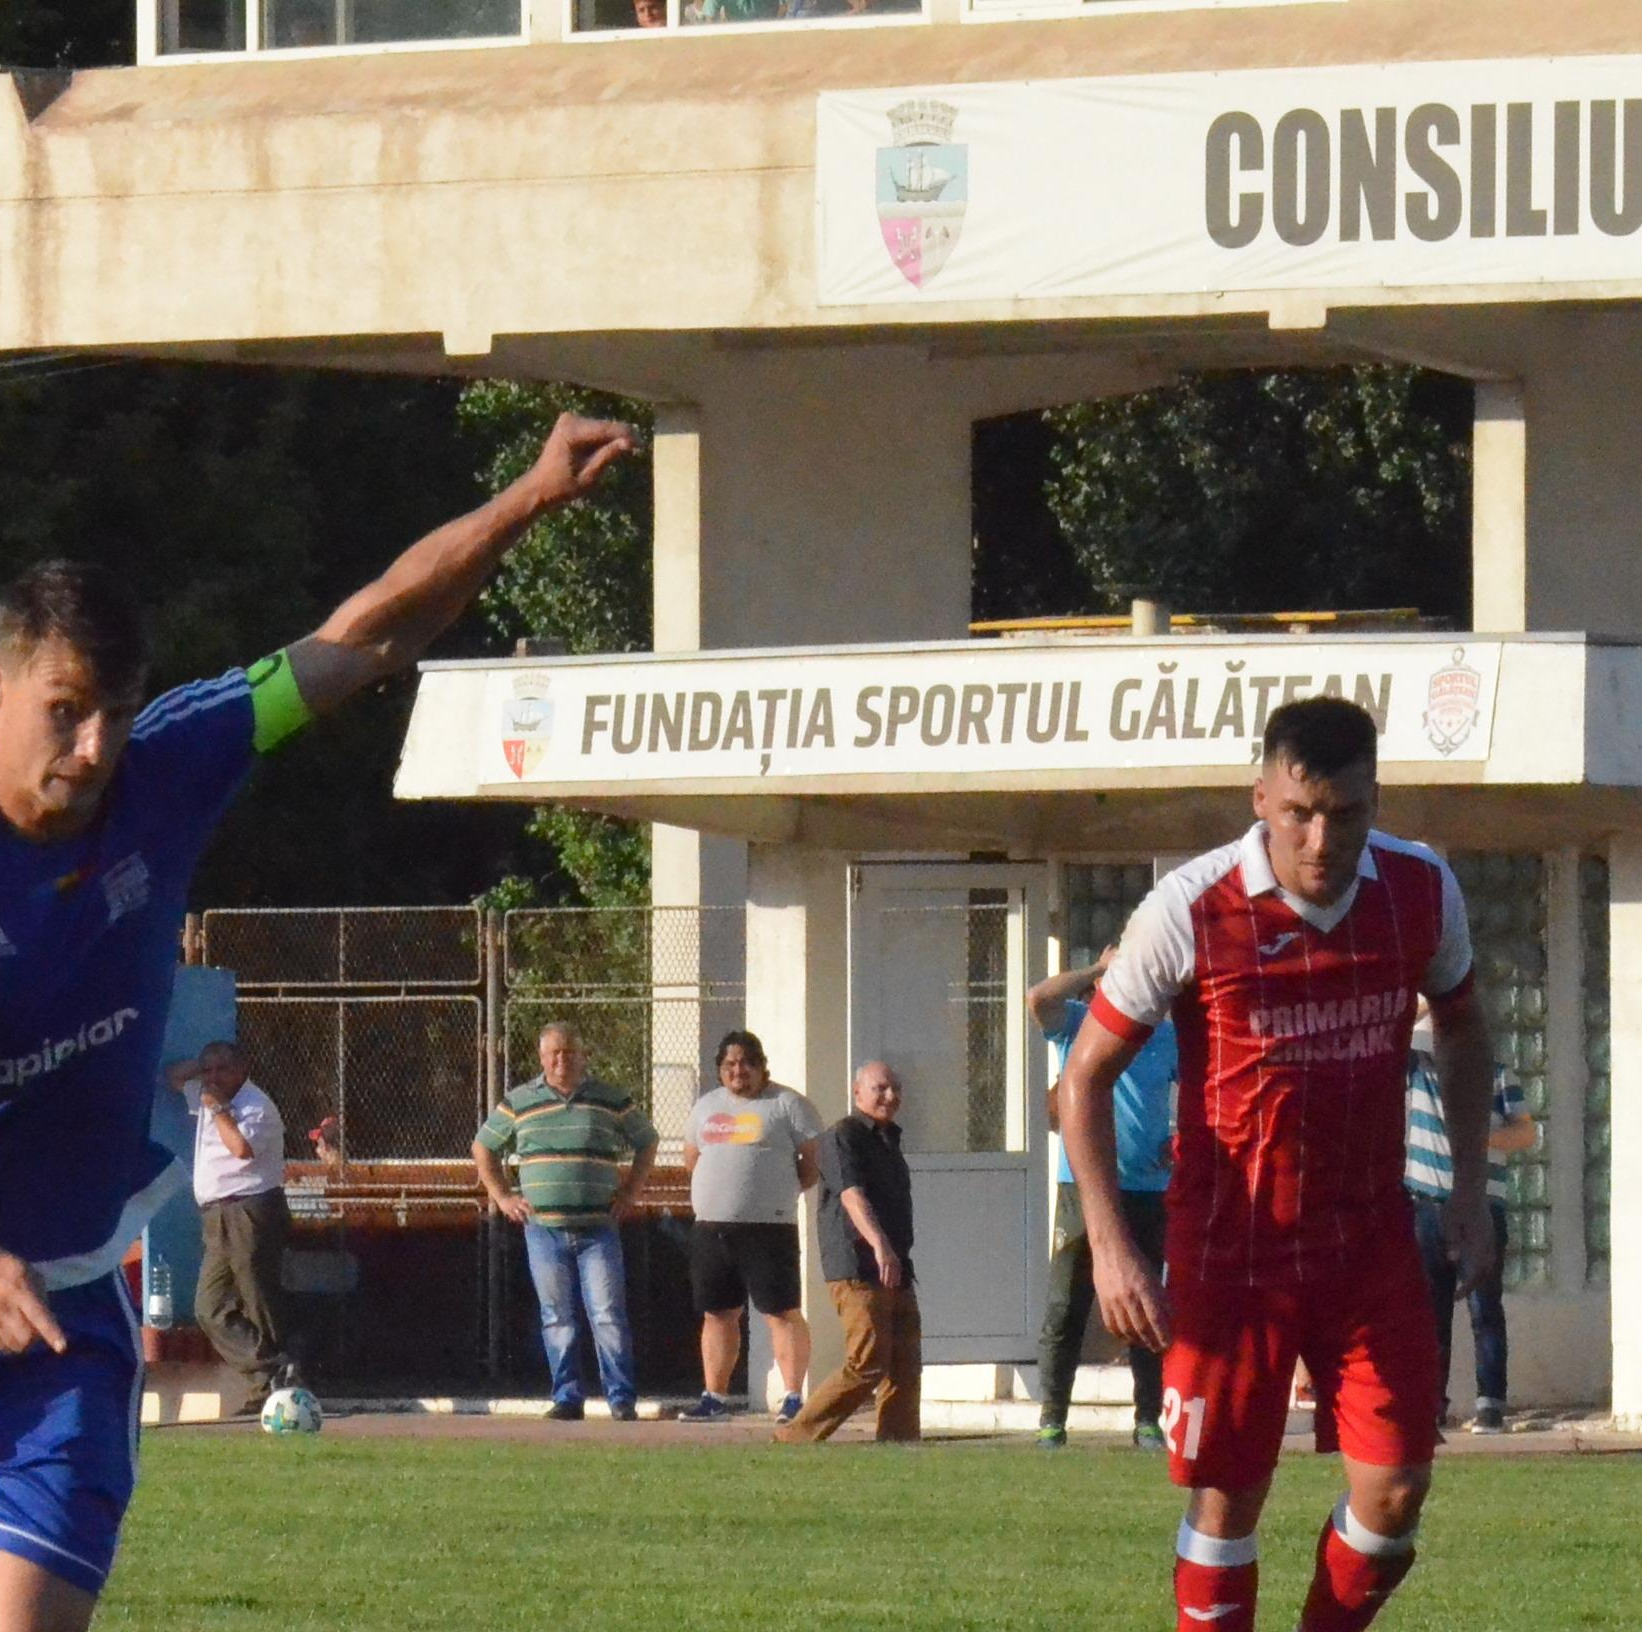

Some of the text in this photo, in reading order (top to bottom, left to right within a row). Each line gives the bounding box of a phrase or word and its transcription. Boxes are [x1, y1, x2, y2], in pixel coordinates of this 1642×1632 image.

[580, 688, 836, 776] FUNDAȚIA
[853, 681, 1090, 748] SPORTUL
[1159, 1387, 1206, 1460] 21
